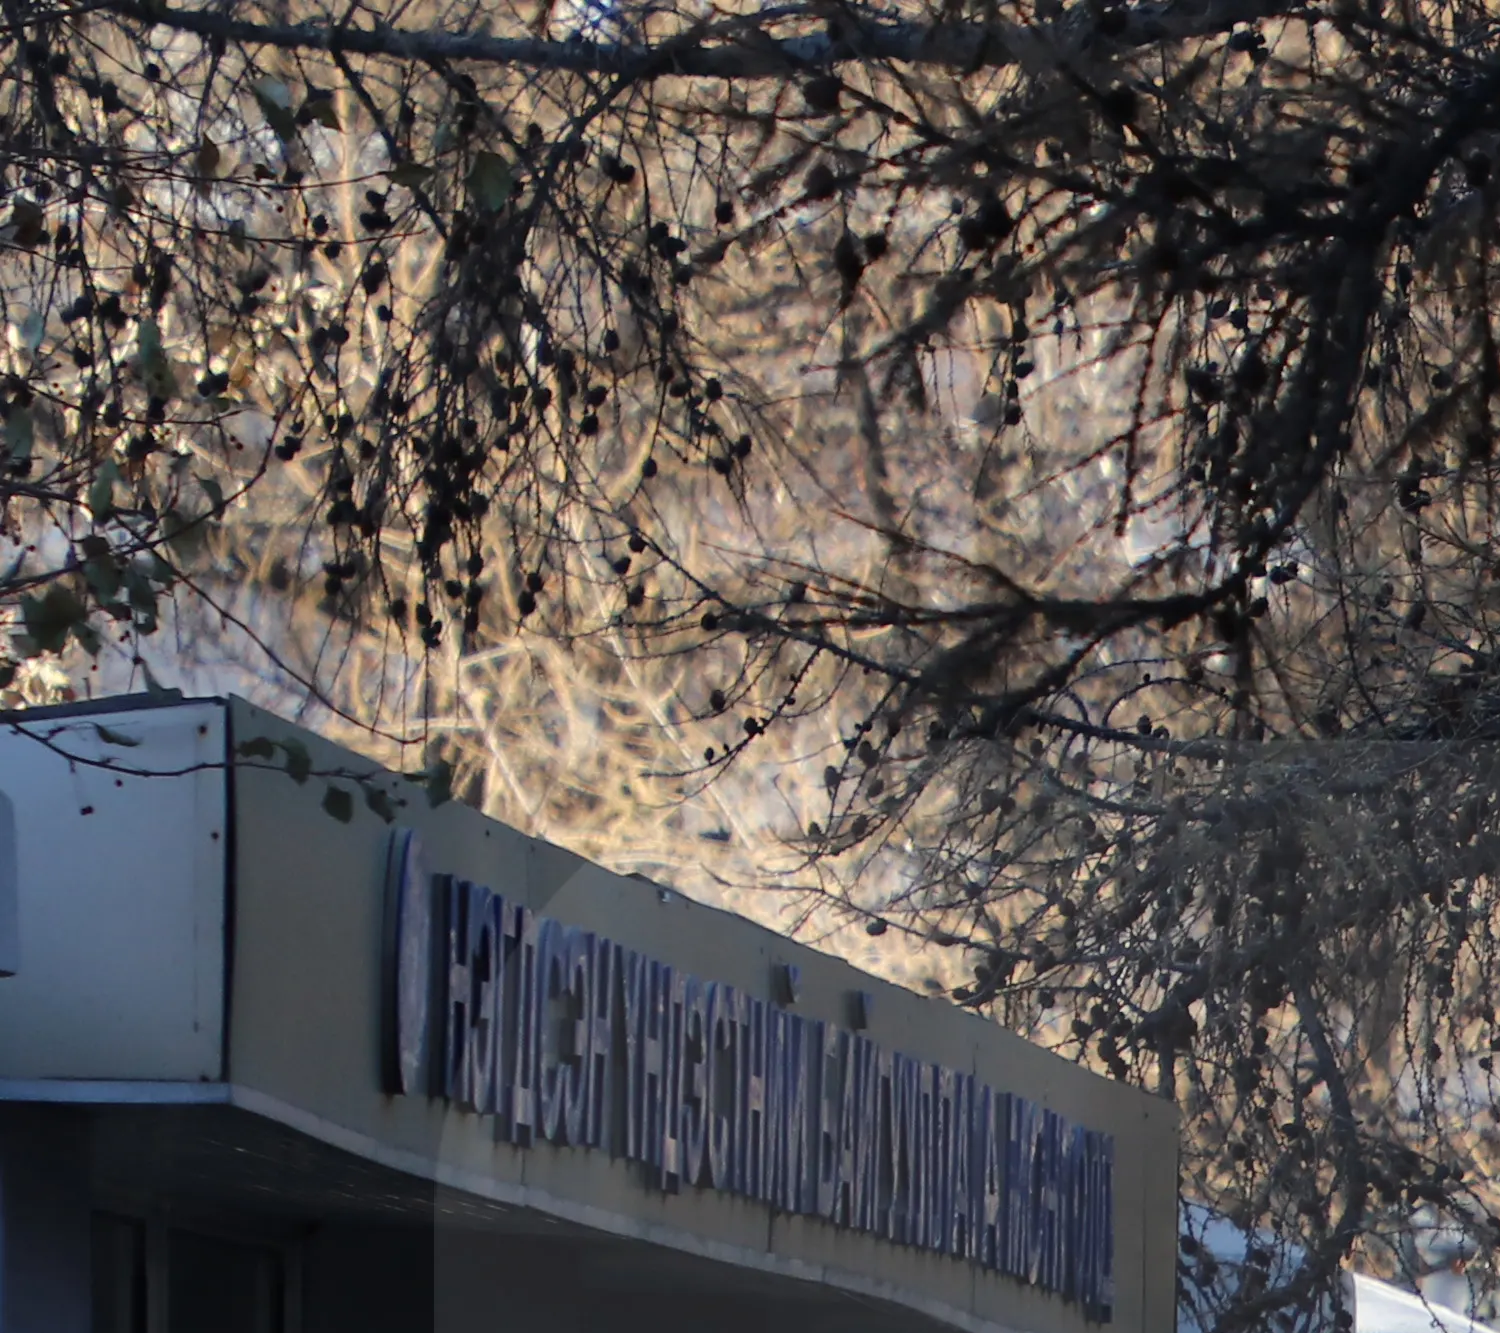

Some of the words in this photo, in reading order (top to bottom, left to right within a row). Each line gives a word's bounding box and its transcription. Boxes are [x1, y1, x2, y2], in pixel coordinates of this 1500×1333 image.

[442, 874, 616, 1150] НЭГДСЭН
[618, 948, 807, 1214] ҮНДЭСТНИЙ
[812, 992, 1002, 1272] БАЙГУУЛЛАГА
